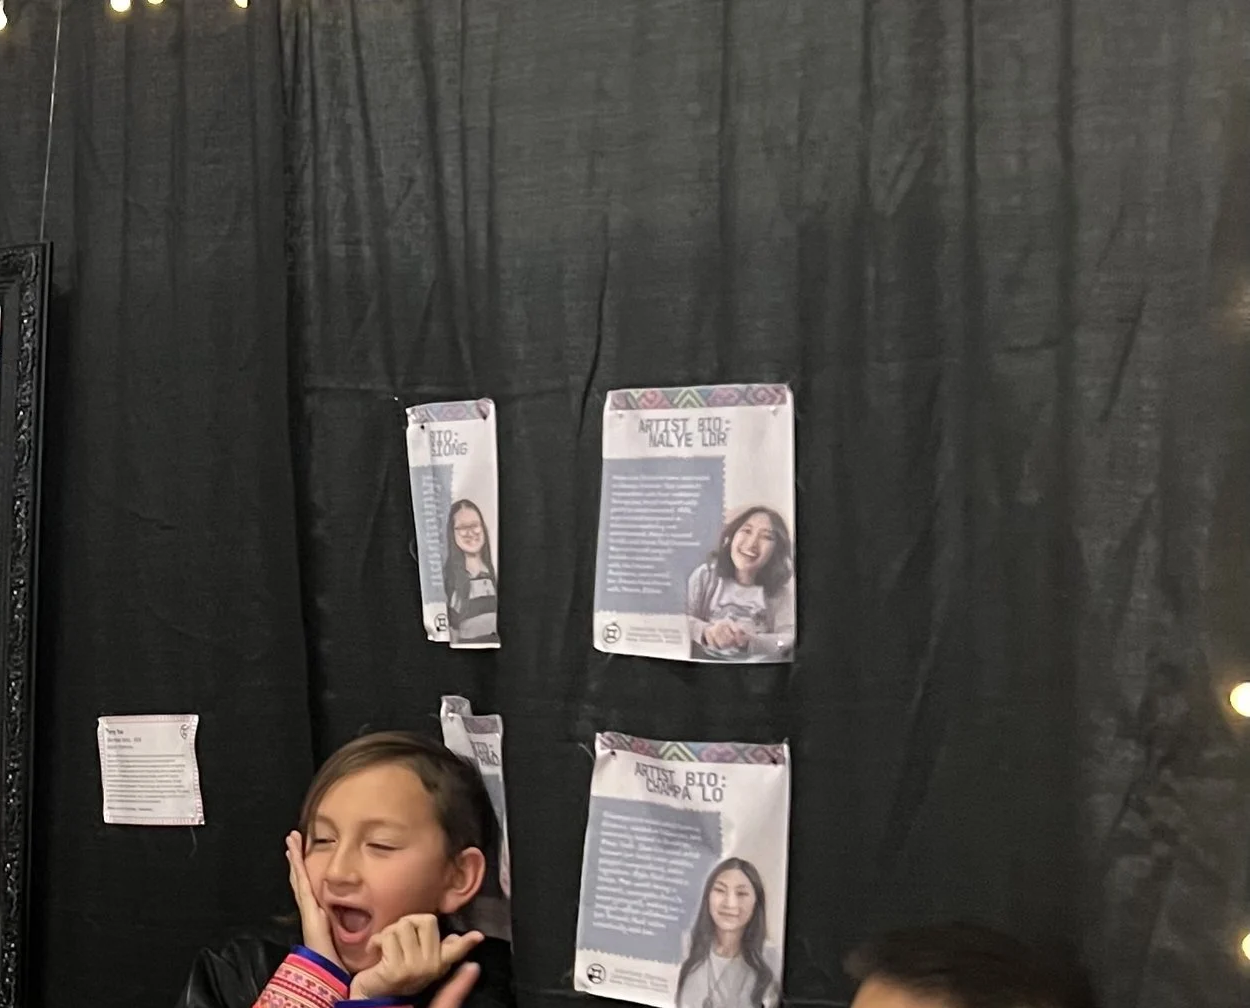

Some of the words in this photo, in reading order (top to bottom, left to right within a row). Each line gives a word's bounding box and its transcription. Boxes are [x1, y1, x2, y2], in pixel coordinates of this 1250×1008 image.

[638, 418, 690, 433] ARTIST
[697, 416, 731, 432] BIO:
[649, 431, 694, 447] NALYE
[634, 761, 675, 784] ARTIST
[685, 771, 726, 787] BIO:
[702, 787, 724, 803] LO
